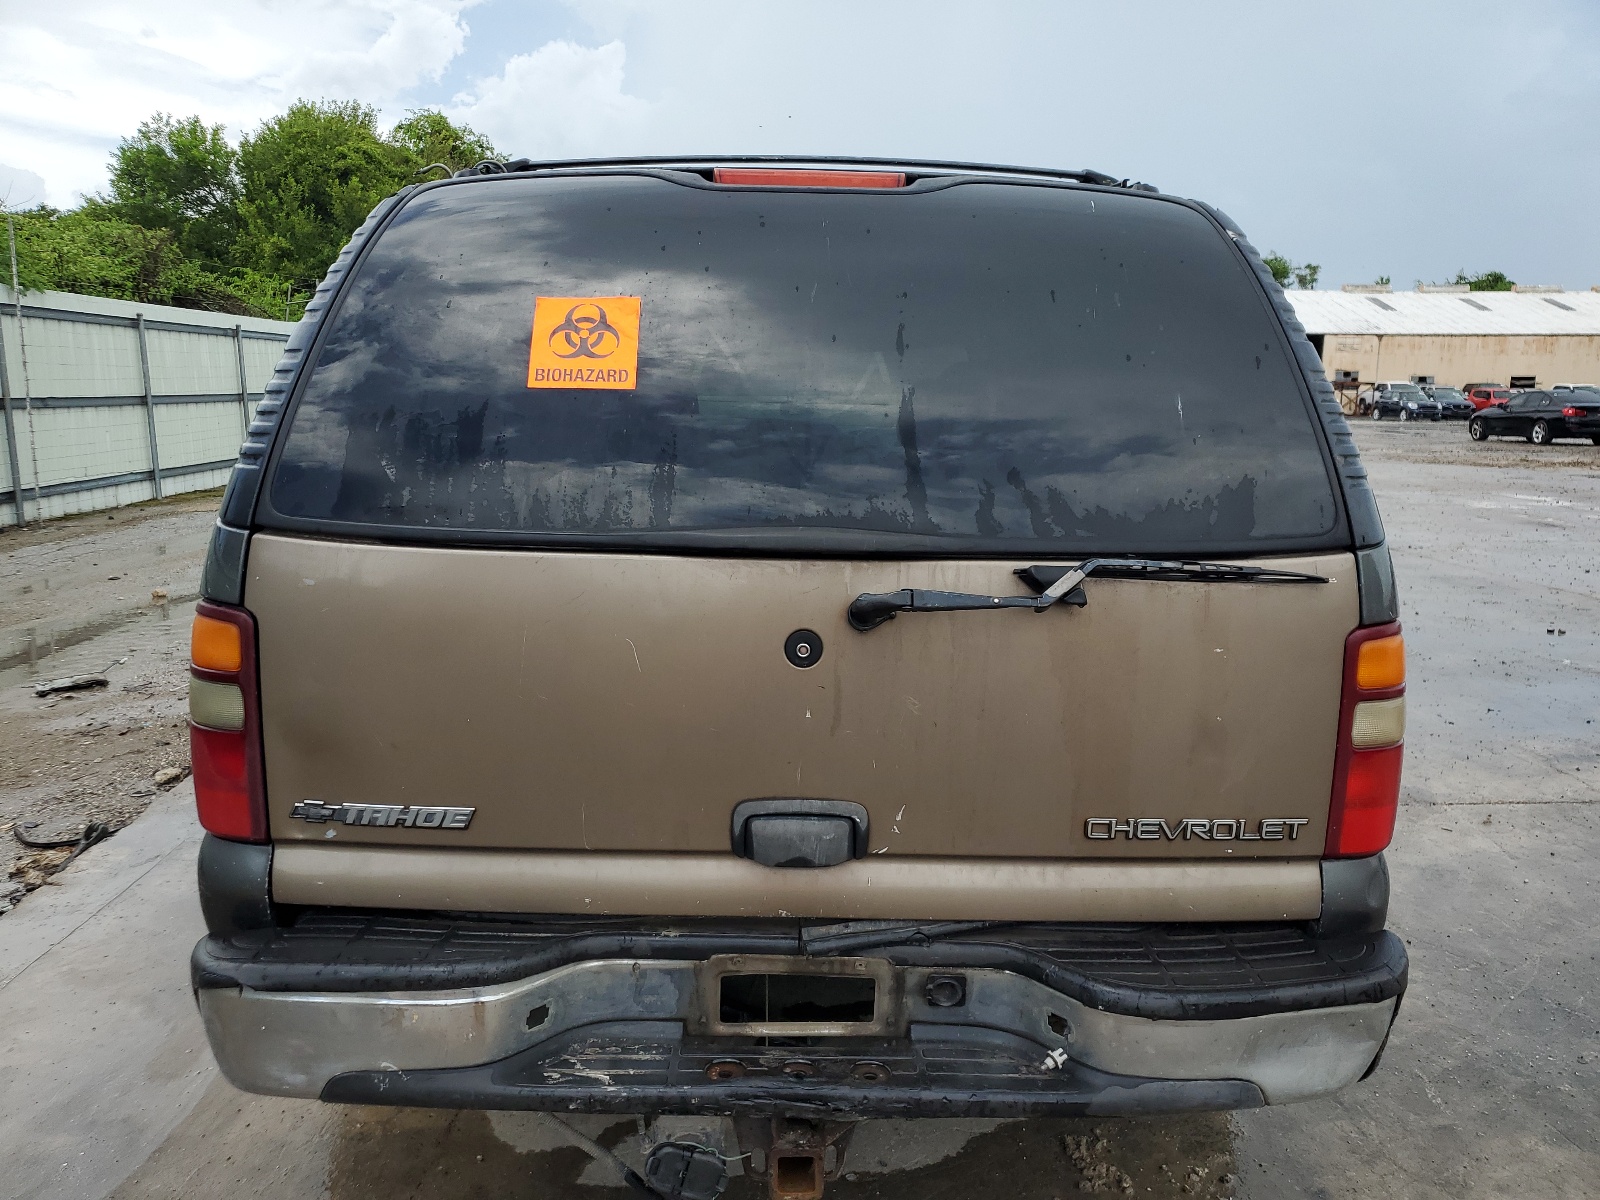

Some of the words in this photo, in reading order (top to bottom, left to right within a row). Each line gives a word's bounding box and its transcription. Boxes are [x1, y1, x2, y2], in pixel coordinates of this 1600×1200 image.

[534, 368, 629, 383] BIOHAZARD
[342, 803, 475, 828] TAHOE
[1085, 817, 1309, 841] CHEVROLET
